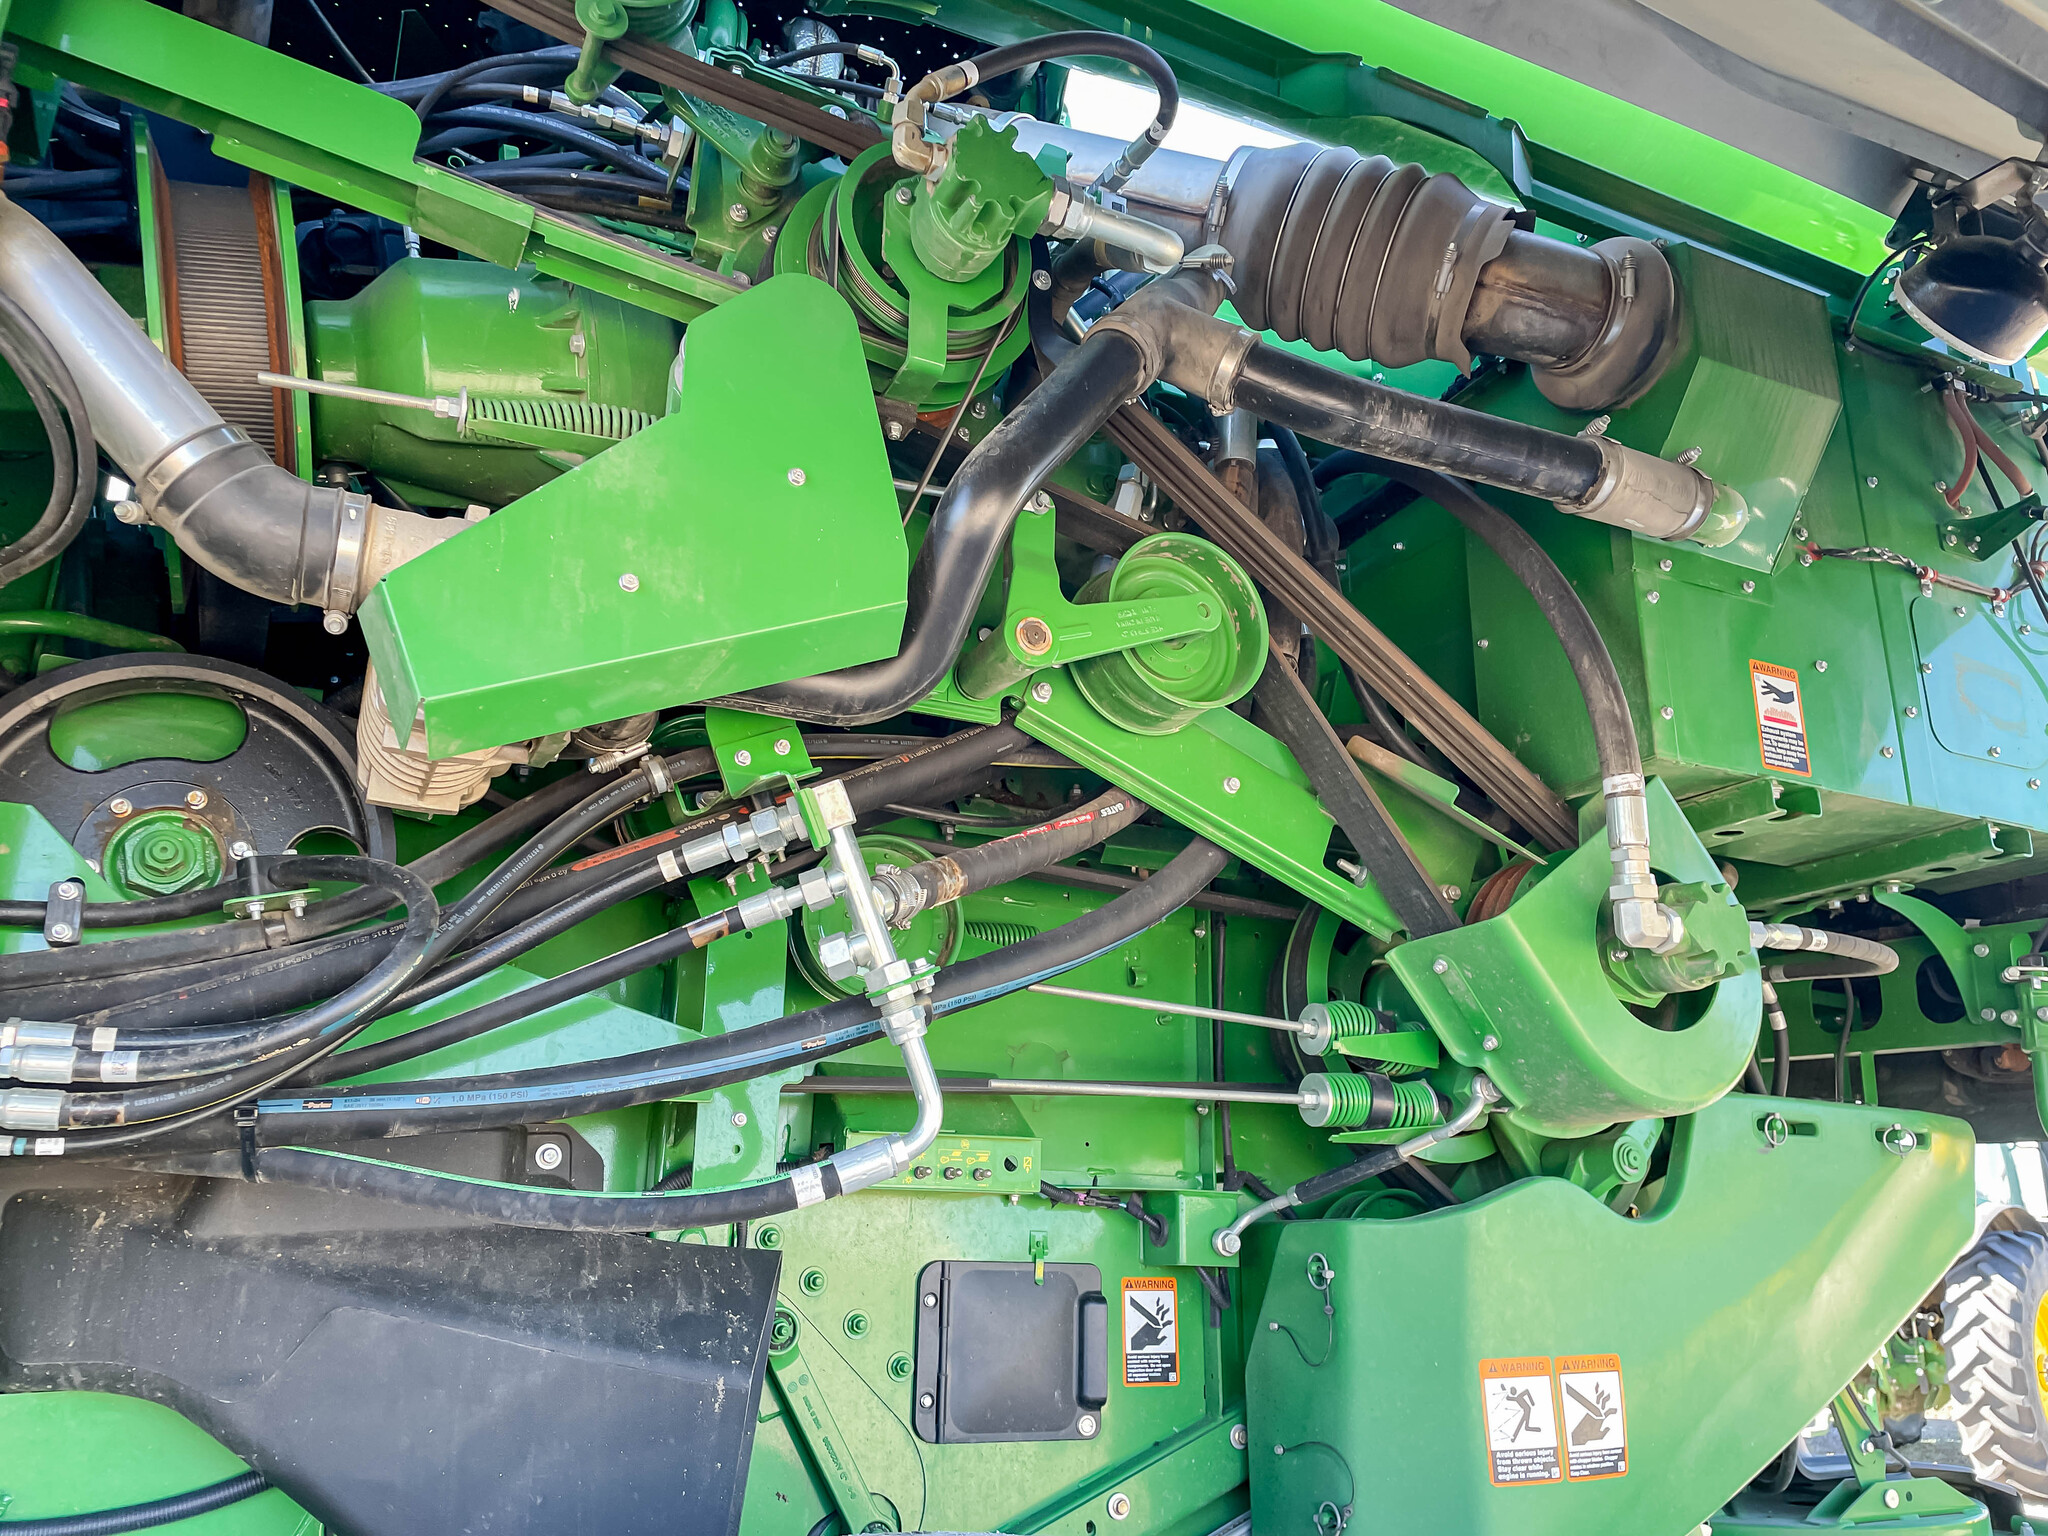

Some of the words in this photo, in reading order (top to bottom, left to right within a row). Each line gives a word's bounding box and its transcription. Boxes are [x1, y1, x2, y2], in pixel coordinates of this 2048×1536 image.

[1759, 664, 1796, 679] WARNING
[1101, 802, 1124, 817] GATES
[488, 1092, 508, 1100] (150
[510, 1090, 528, 1099] PSI)
[1134, 1280, 1173, 1288] WARNING
[1500, 1362, 1544, 1372] WARNING
[1572, 1359, 1615, 1369] WARNING
